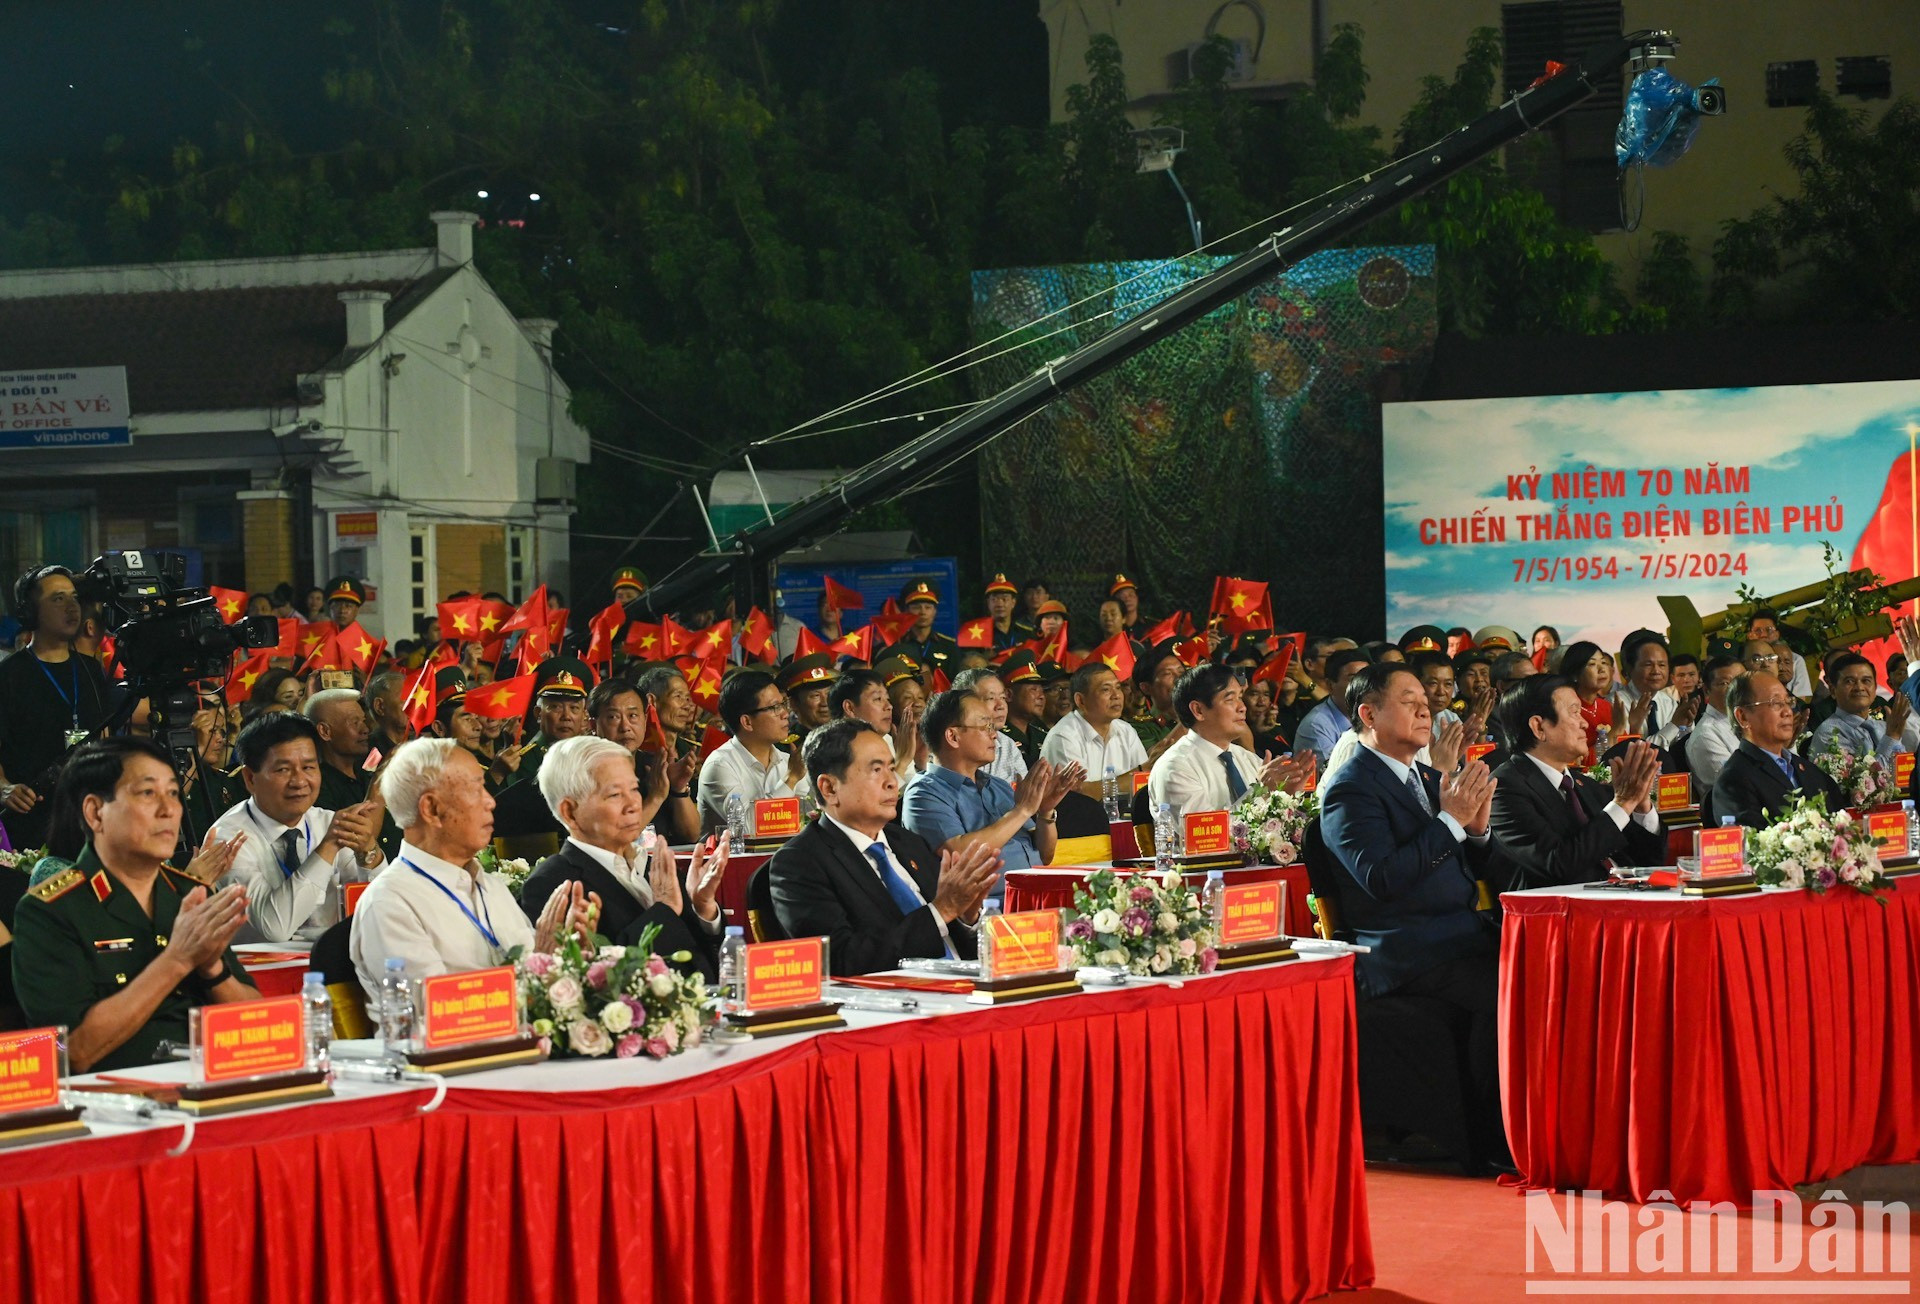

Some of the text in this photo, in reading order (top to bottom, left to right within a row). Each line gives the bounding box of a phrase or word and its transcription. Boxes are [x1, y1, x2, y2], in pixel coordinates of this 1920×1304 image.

[12, 394, 111, 415] BÁN VÉ
[12, 418, 72, 429] OFFICE
[34, 430, 110, 442] vinaphone
[1506, 462, 1750, 504] KỶ NIỆM 70 NĂM
[1419, 496, 1844, 545] CHIẾN THẮNG ĐIỆN BIÊN PHỦ
[130, 554, 139, 564] 2
[1512, 556, 1618, 583] 7/5/1954
[1639, 552, 1748, 580] 7/5/2024
[772, 812, 775, 820] A
[1206, 826, 1210, 835] A
[1211, 824, 1222, 835] SƠN
[1243, 902, 1261, 916] THANH
[754, 959, 813, 980] NGUYỄN VĂN AN
[214, 1030, 239, 1050] PHẠM
[241, 1026, 269, 1045] THANH
